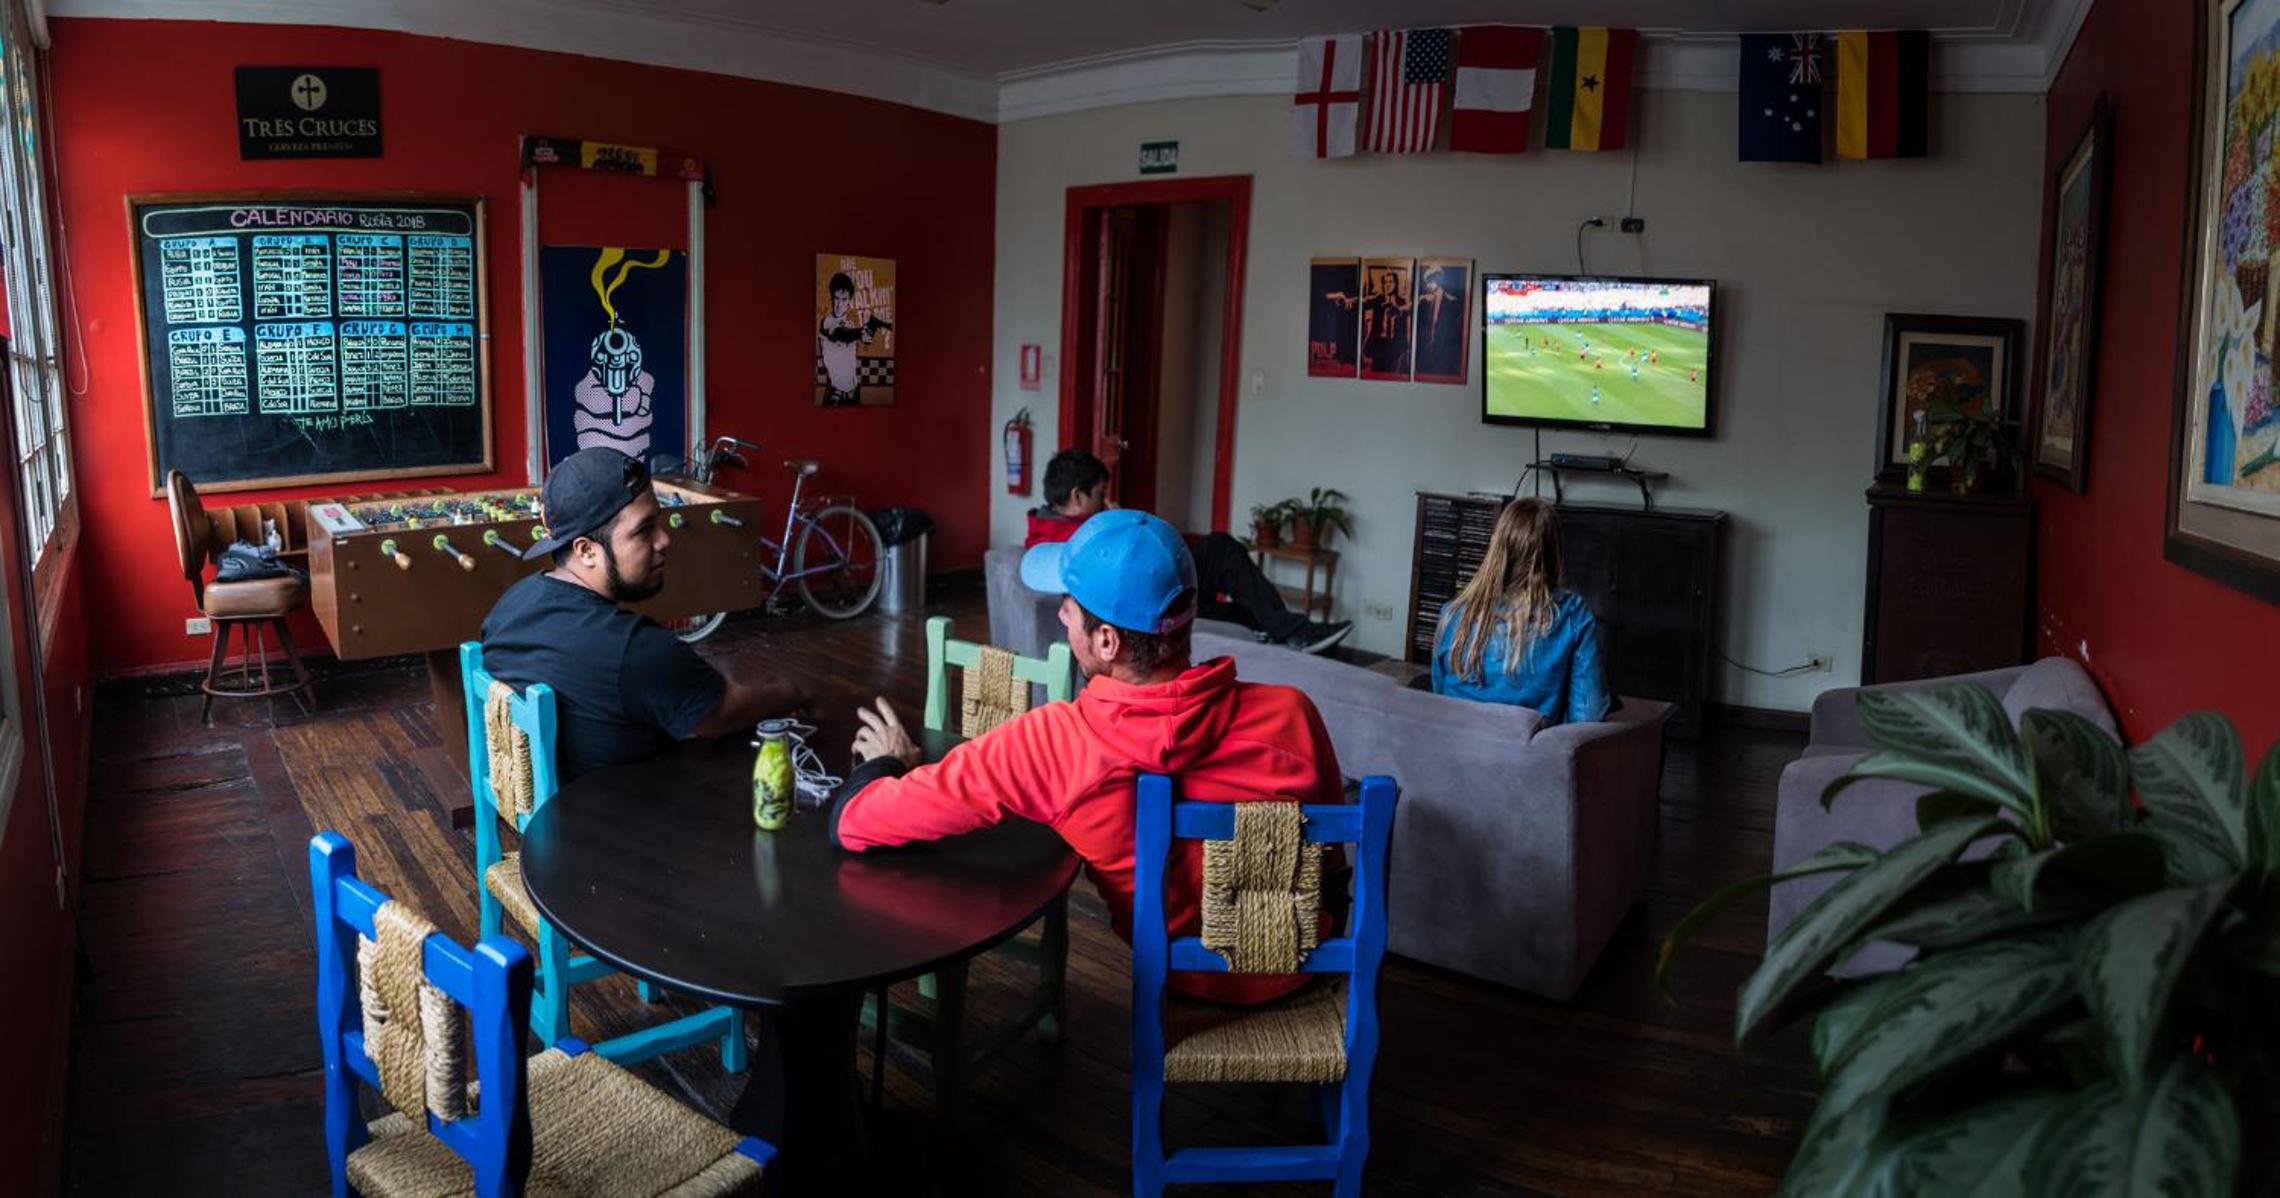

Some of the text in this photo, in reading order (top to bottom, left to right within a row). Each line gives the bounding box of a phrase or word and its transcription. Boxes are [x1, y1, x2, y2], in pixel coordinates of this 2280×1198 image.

[243, 117, 377, 137] TRES CRUCES
[230, 209, 353, 227] CALENDARIO
[396, 214, 426, 229] 2018
[223, 329, 231, 341] E
[257, 325, 302, 337] GRUPO
